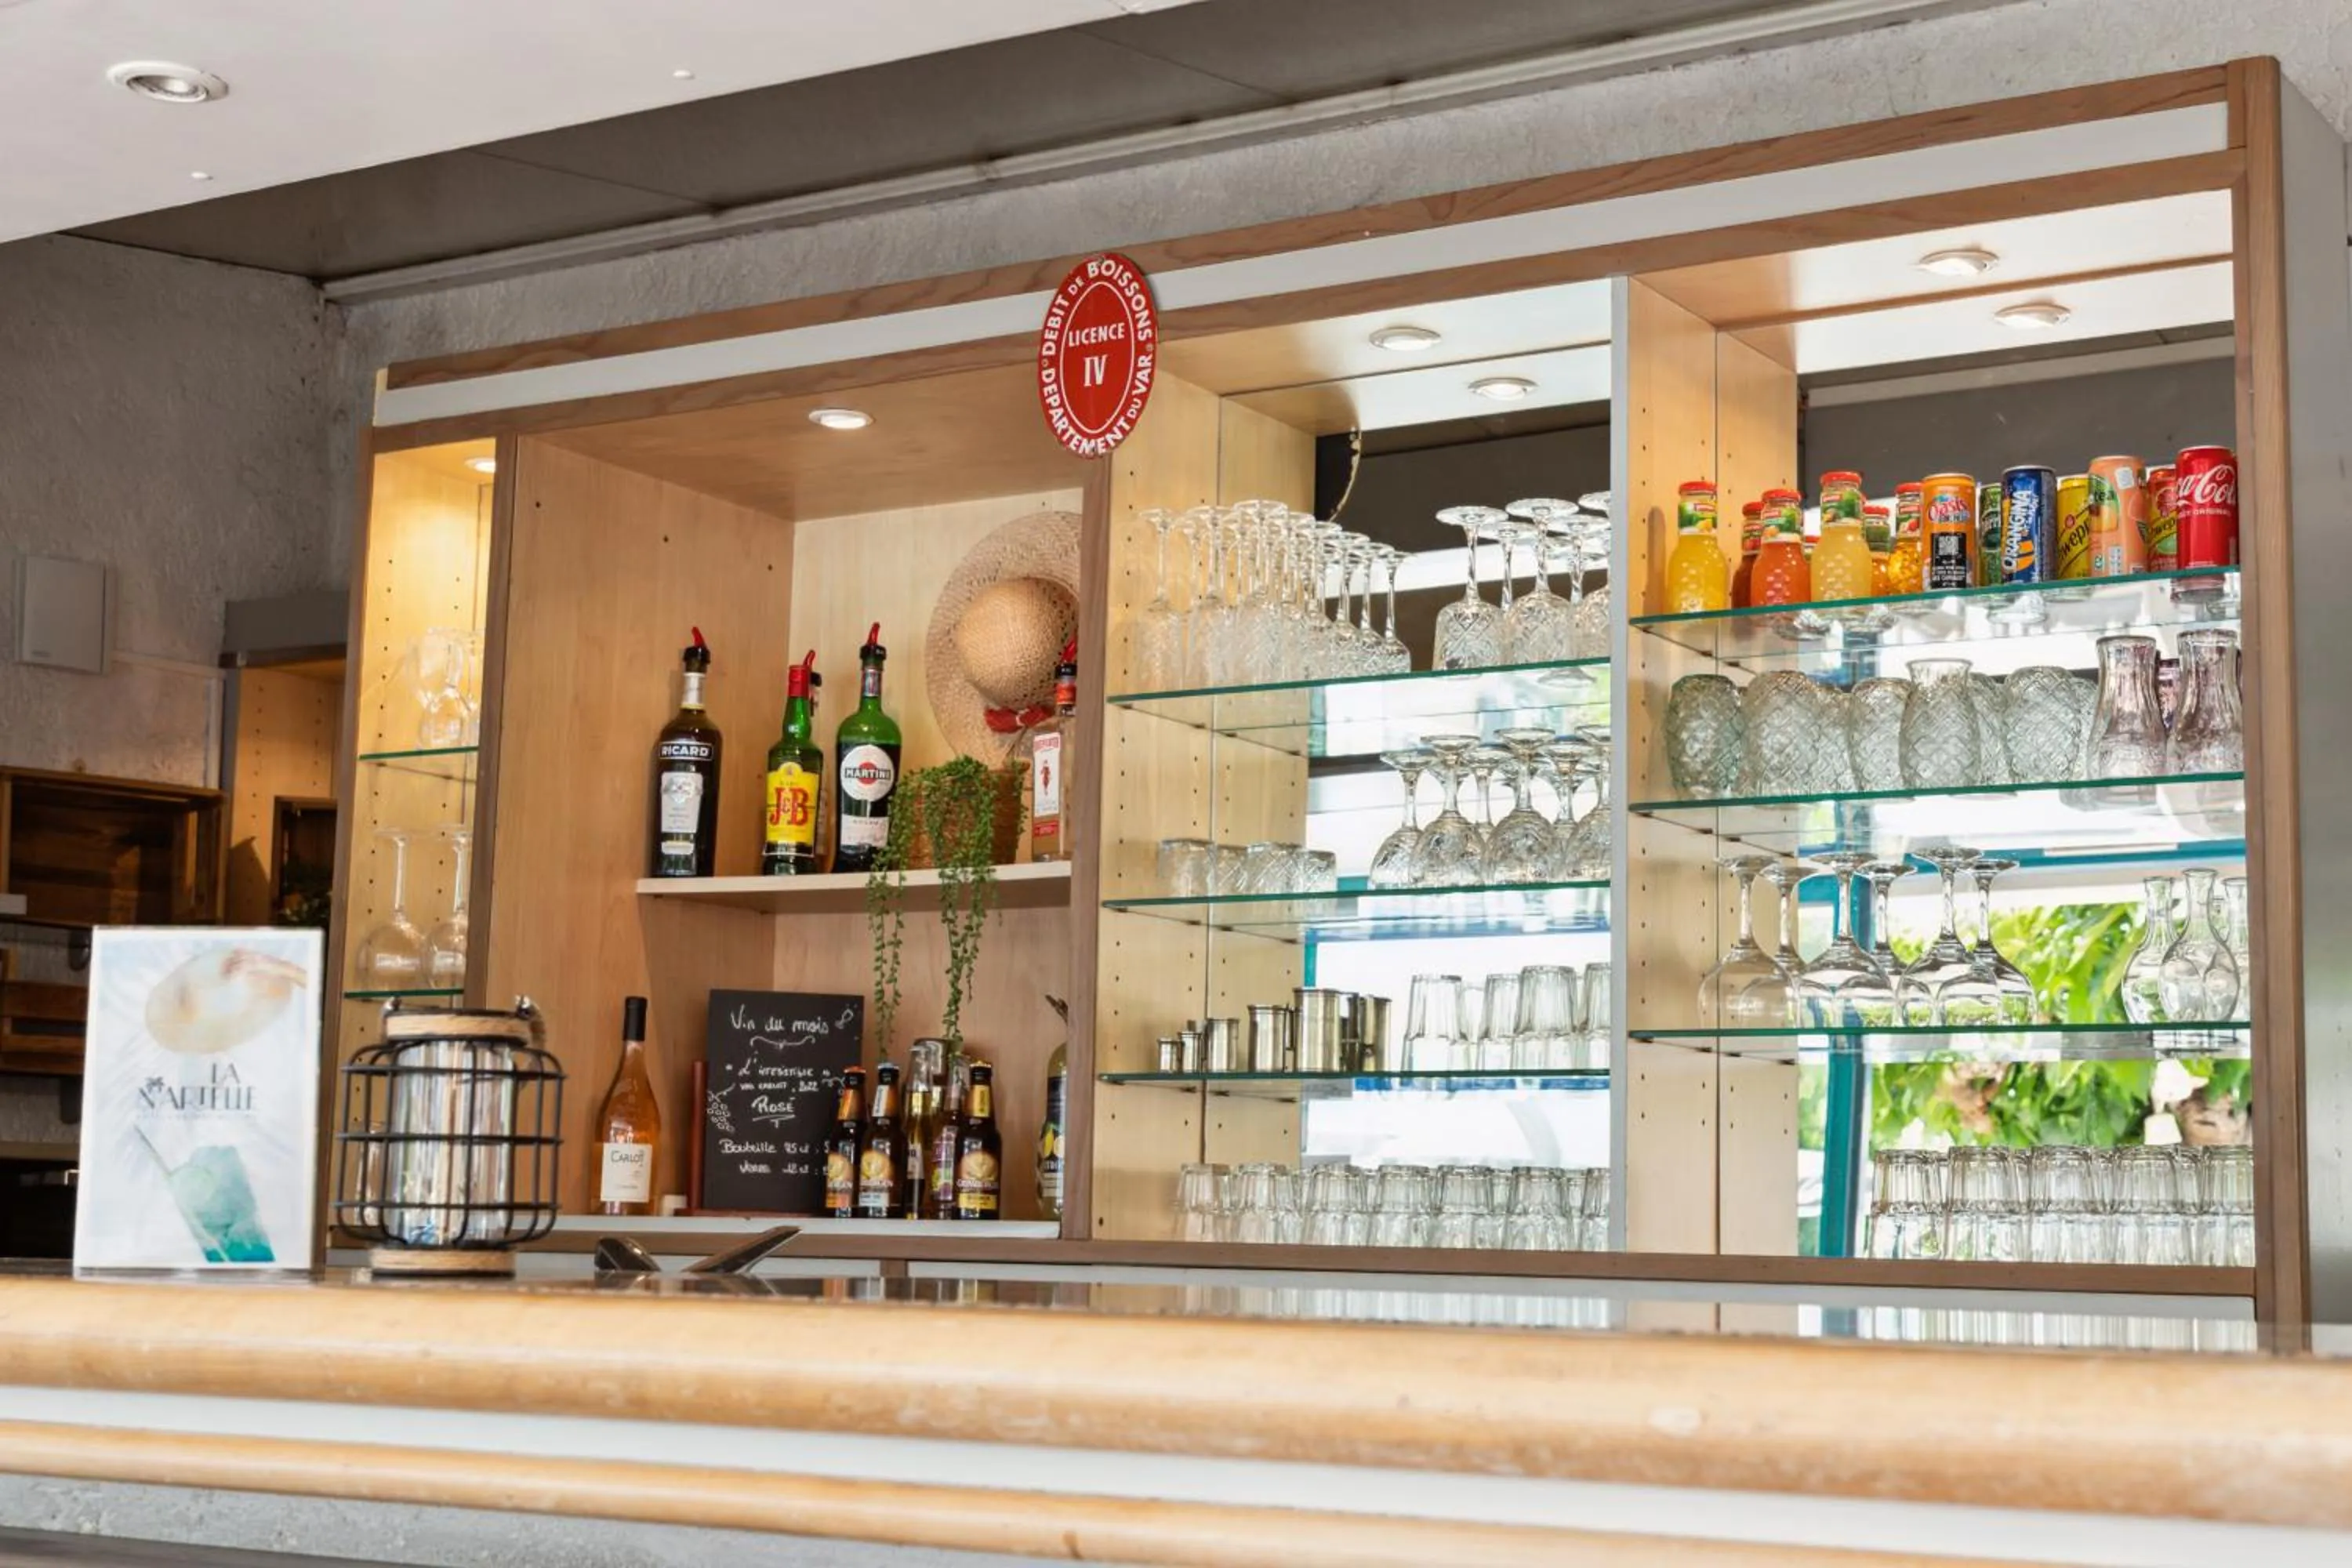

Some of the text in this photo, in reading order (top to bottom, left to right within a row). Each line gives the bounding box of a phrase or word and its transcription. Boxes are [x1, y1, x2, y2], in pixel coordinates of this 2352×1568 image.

[1042, 260, 1152, 356] DEBIT DE BOISSONS
[1069, 322, 1125, 347] LICENCE
[1083, 354, 1108, 387] IV
[1042, 354, 1152, 456] DEPARTEMENT DU VAR
[2003, 490, 2033, 574] ORANGINA
[661, 746, 709, 757] RICARD
[845, 768, 891, 779] MARTINI
[730, 1004, 829, 1034] Vin du mois
